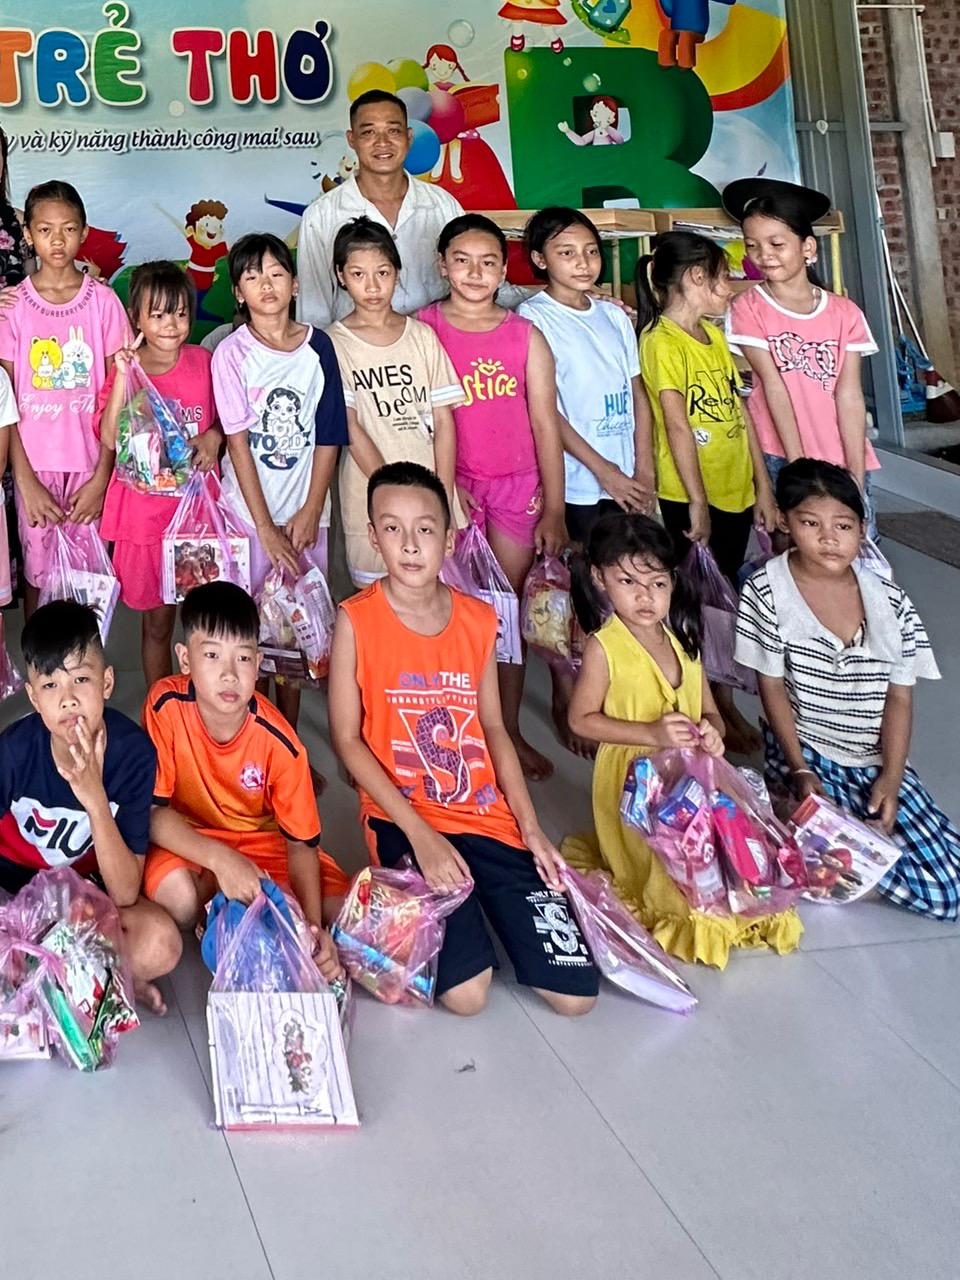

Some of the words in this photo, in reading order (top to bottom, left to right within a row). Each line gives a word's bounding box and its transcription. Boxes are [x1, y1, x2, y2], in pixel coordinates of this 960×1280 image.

[171, 19, 333, 107] THƠ
[21, 130, 44, 149] và
[49, 130, 74, 153] kỹ
[77, 130, 126, 153] năng
[131, 129, 189, 148] thành
[193, 128, 238, 150] công
[242, 127, 280, 147] mai
[283, 131, 318, 146] sau
[40, 306, 78, 318] BURBERRY
[351, 364, 413, 391] AWES
[20, 393, 63, 420] Enjoy
[400, 672, 439, 687] ONLY
[439, 672, 471, 688] THE
